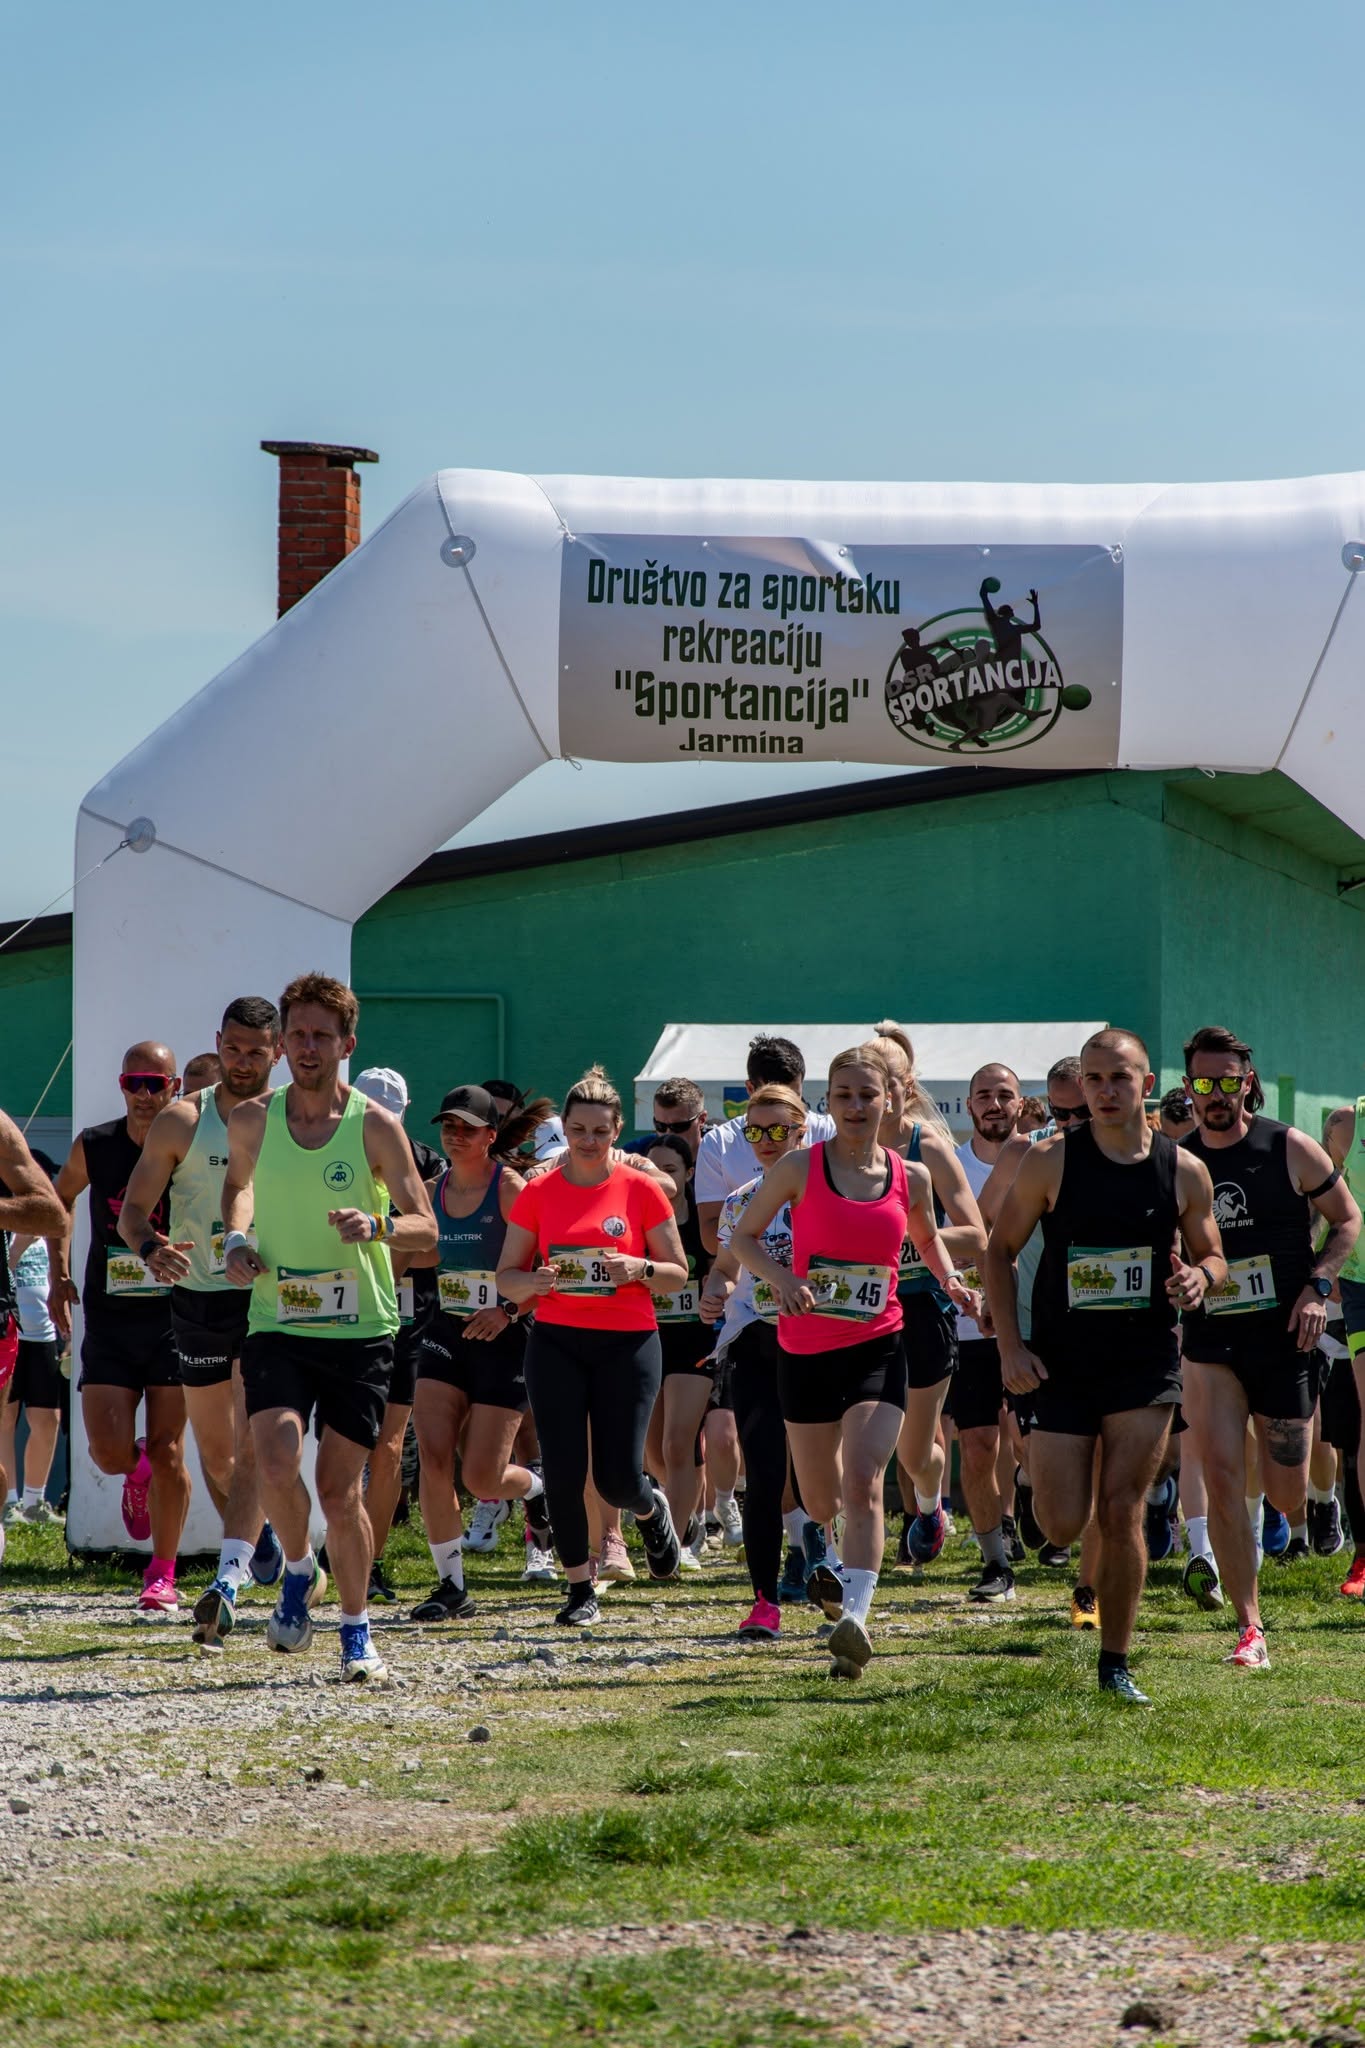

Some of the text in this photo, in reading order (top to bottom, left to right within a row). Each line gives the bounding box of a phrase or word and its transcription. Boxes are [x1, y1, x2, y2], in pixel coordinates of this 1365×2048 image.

[588, 558, 899, 620] Društvo za sportsku
[663, 619, 822, 674] rekreaciju
[885, 663, 935, 698] DSR
[889, 659, 1062, 726] SPORTANCIJA
[615, 670, 869, 730] "Sportancija"
[679, 728, 803, 754] Jarmina
[1238, 1218, 1254, 1227] DIVE
[1123, 1266, 1143, 1291] 19
[1247, 1272, 1265, 1295] 11
[333, 1287, 345, 1310] 7
[478, 1284, 488, 1305] 9
[678, 1293, 693, 1311] 13
[855, 1281, 882, 1307] 45
